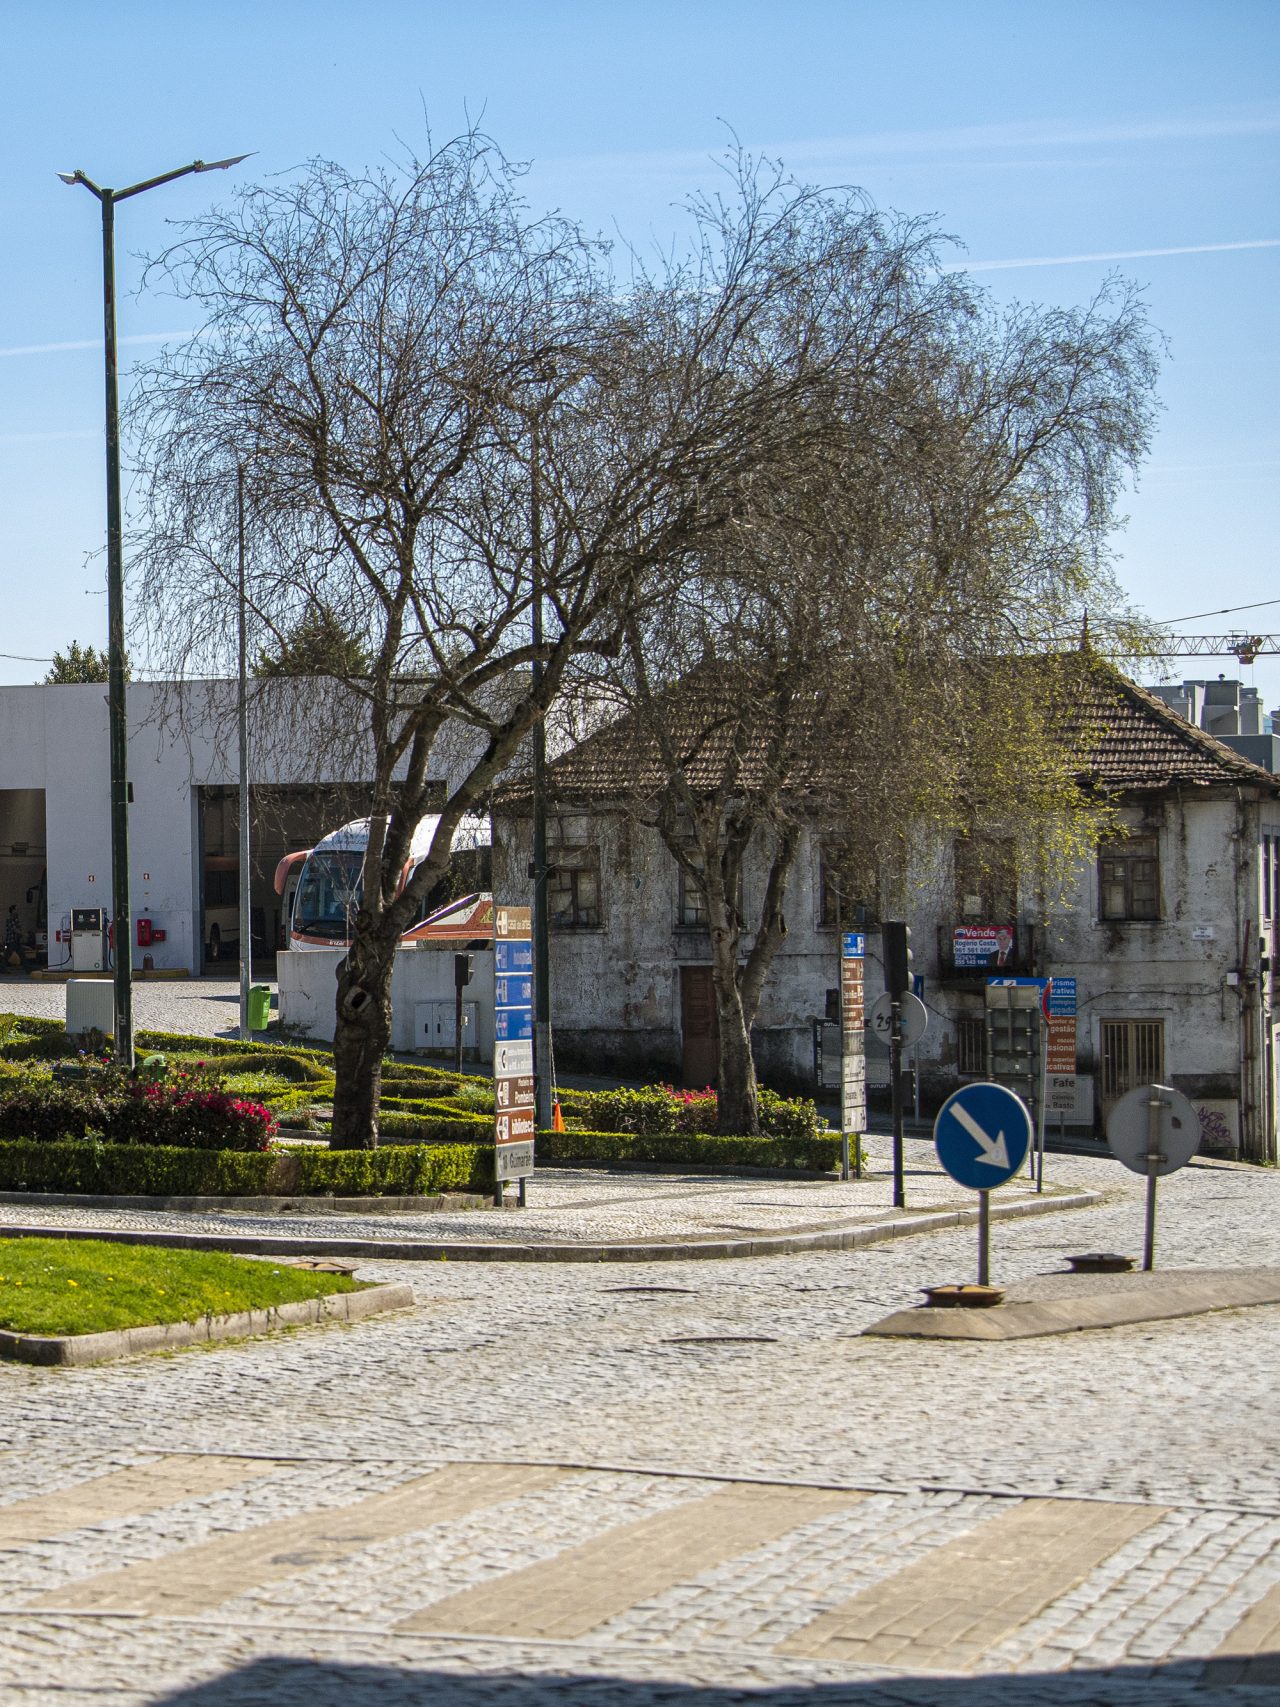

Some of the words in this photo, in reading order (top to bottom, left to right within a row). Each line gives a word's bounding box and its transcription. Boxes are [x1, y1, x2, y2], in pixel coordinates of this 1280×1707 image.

[965, 928, 996, 937] Vende
[1052, 1078, 1076, 1087] Fafe
[1053, 1101, 1075, 1109] Basto
